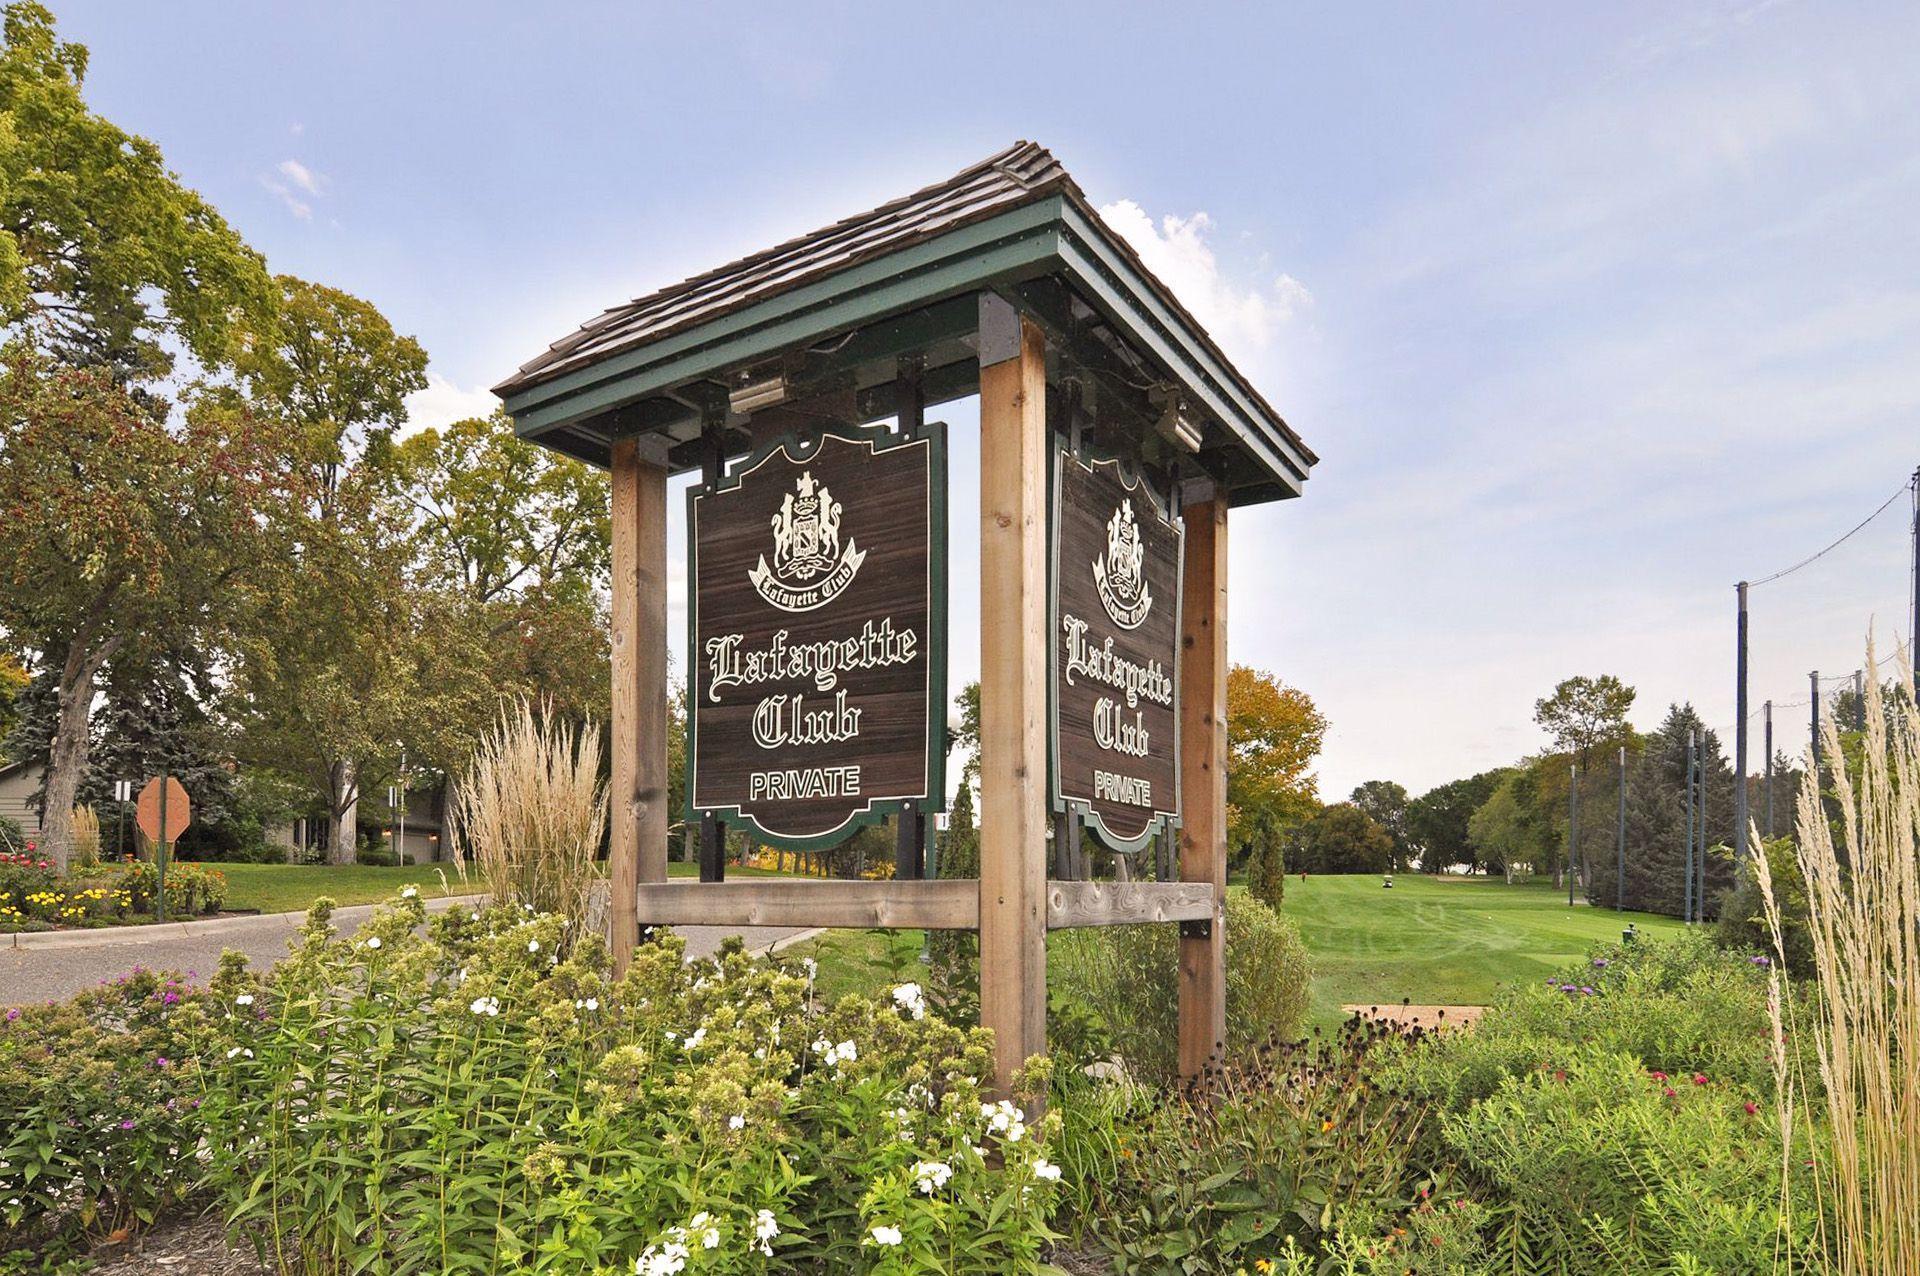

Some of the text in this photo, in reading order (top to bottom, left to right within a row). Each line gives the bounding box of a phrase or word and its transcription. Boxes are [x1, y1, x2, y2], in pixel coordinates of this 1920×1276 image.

[762, 567, 851, 608] Lafayette Club
[706, 617, 917, 702] Lafayette
[1063, 614, 1172, 708] Lafayette
[753, 689, 862, 749] Club
[1093, 697, 1149, 758] Club
[750, 766, 860, 801] PRIVATE
[1094, 770, 1151, 807] PRIVATE
